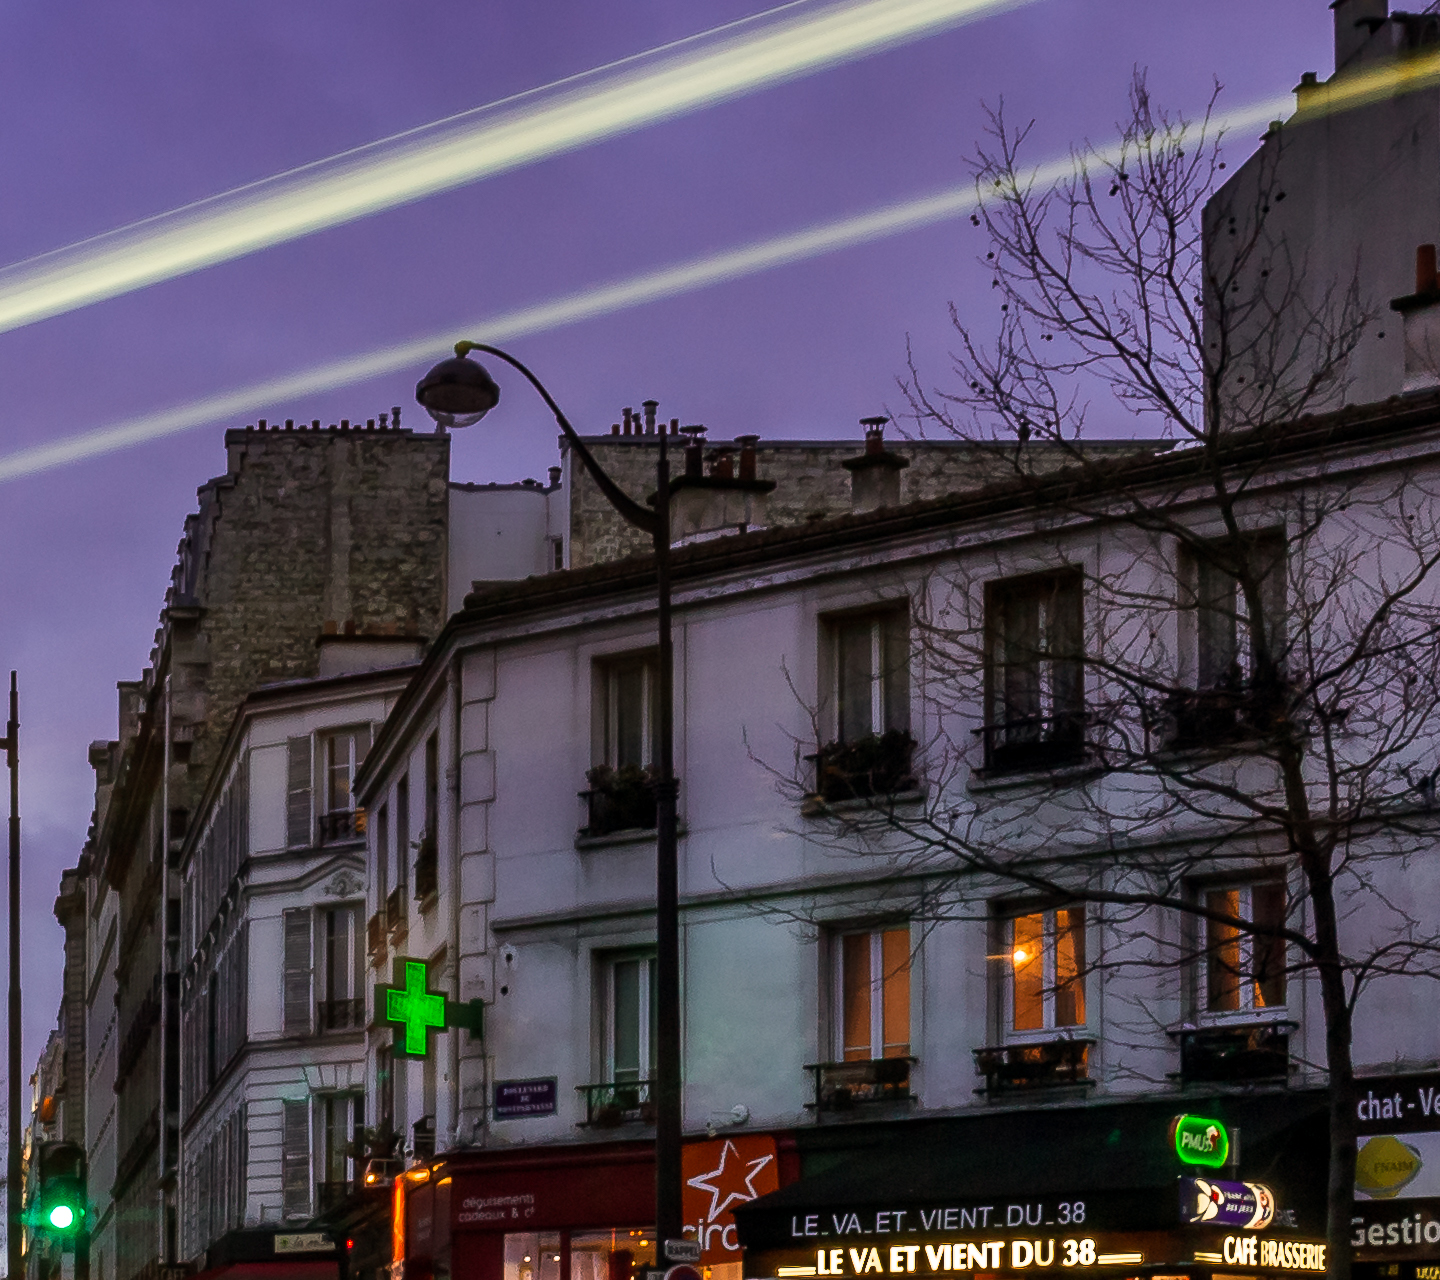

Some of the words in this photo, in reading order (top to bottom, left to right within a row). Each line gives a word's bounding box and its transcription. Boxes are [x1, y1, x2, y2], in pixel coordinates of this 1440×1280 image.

[1357, 1091, 1403, 1120] chat
[1182, 1131, 1205, 1151] PMU
[1374, 1160, 1413, 1173] FNAIM
[792, 1215, 819, 1237] LE
[832, 1213, 862, 1235] VA
[876, 1211, 907, 1233] ET
[921, 1206, 994, 1231] VIENT
[1007, 1203, 1042, 1227] DU
[1058, 1202, 1086, 1225] 38
[818, 1248, 843, 1275] LE
[849, 1247, 883, 1274] VA
[890, 1245, 920, 1273] ET
[925, 1241, 1005, 1272] VIENT
[1011, 1239, 1055, 1268] DU
[1063, 1238, 1096, 1267] 38
[1224, 1235, 1258, 1266] CAFÉ
[1261, 1240, 1327, 1271] BRASSERIE
